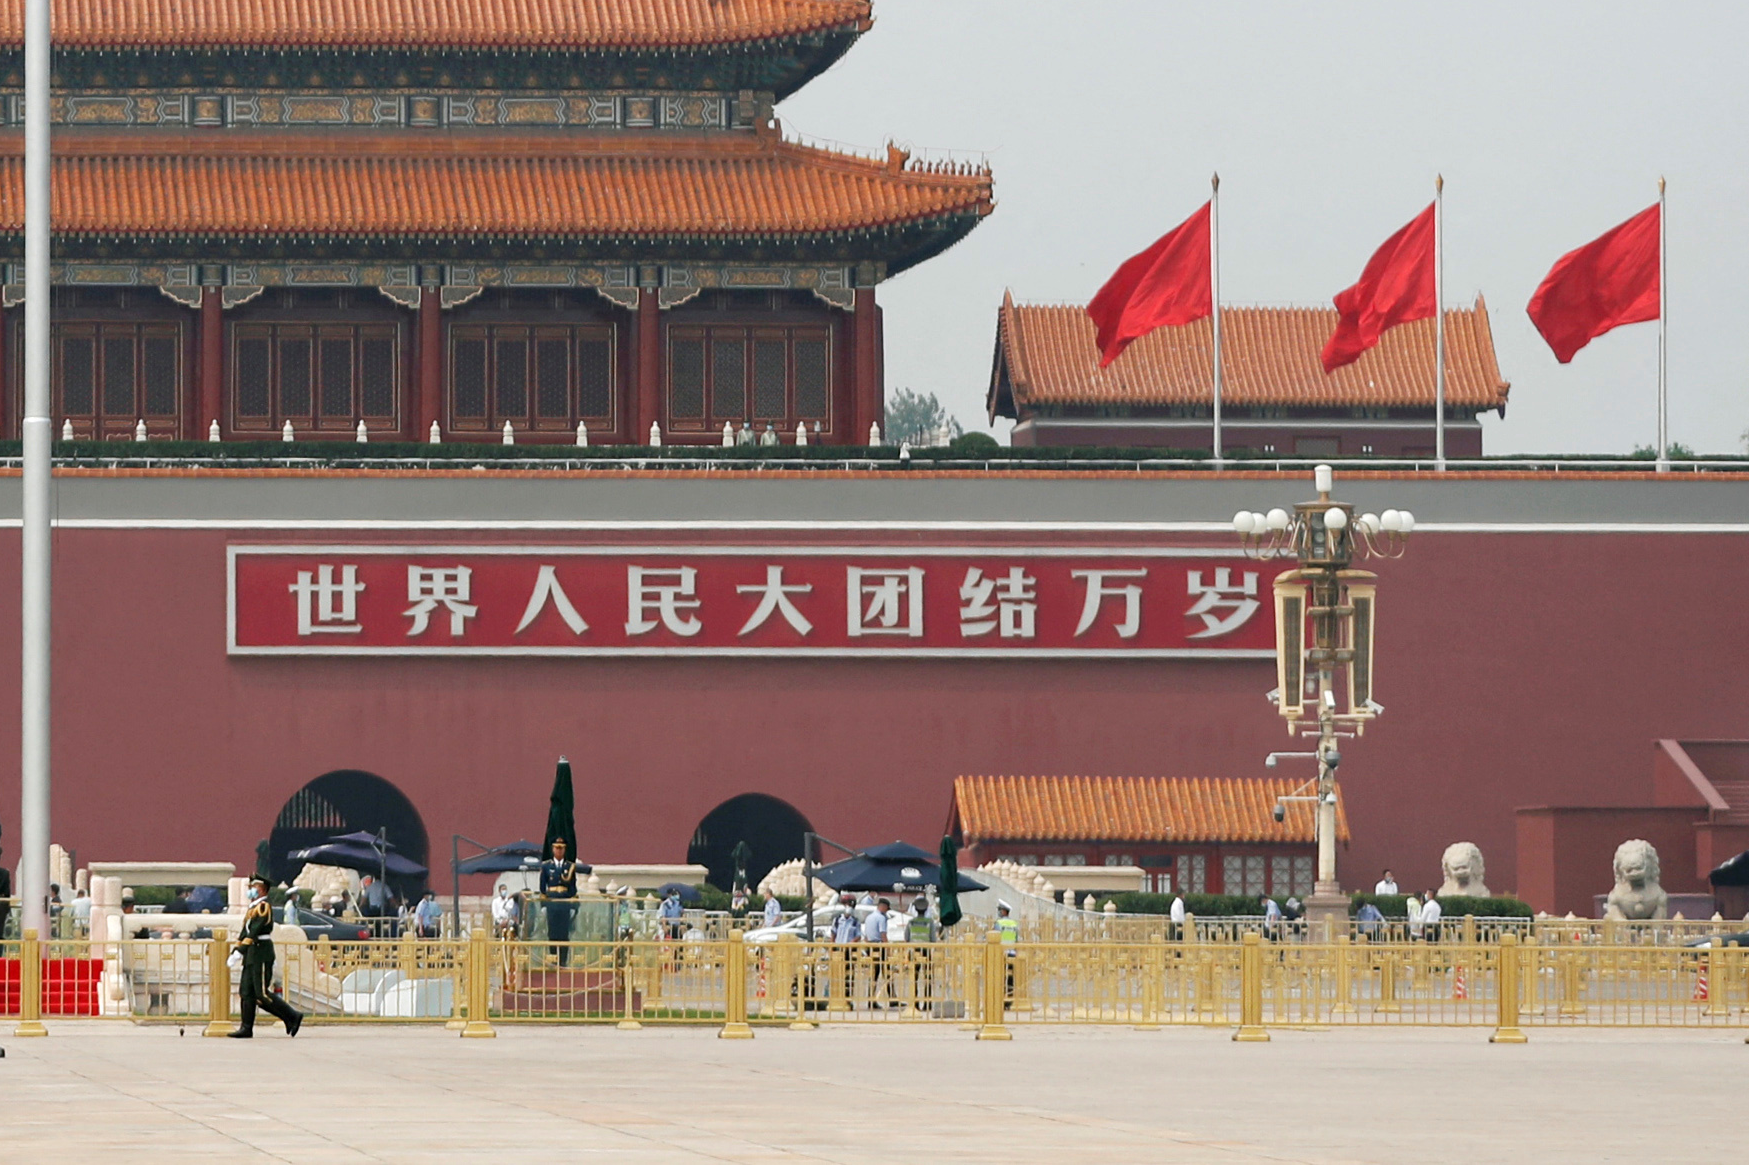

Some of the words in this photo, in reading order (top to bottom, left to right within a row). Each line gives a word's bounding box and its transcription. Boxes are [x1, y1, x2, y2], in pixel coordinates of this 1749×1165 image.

[287, 564, 1261, 639] 世界人民大团结万岁
